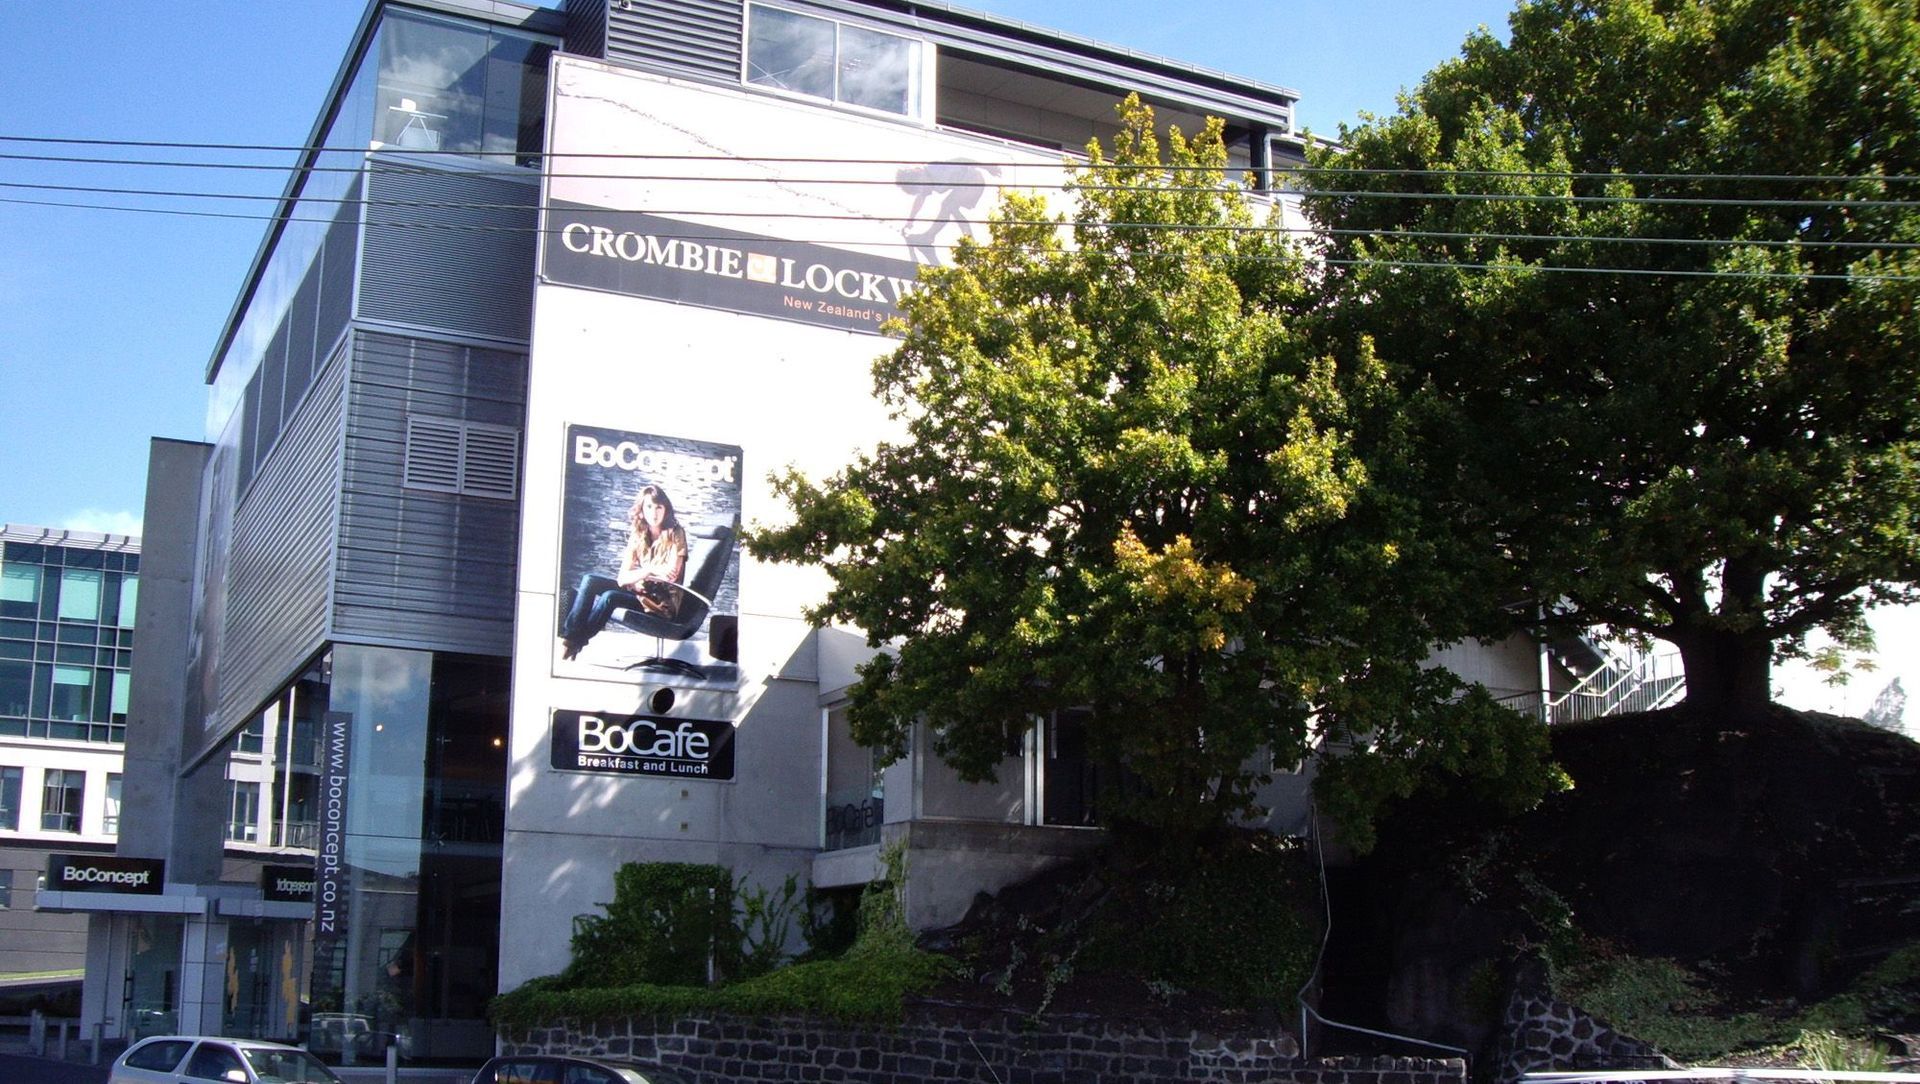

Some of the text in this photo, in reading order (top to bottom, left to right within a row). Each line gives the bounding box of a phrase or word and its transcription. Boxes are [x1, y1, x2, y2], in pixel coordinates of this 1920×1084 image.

[562, 222, 743, 279] CROMBIE
[784, 295, 813, 311] New
[817, 300, 882, 322] Zealand's
[575, 435, 737, 487] BoCopt
[578, 715, 710, 759] BoCafe
[578, 755, 709, 774] Breakfast and Lunch
[321, 722, 347, 933] www.boconcept.co.nz
[63, 866, 149, 887] BoConcept
